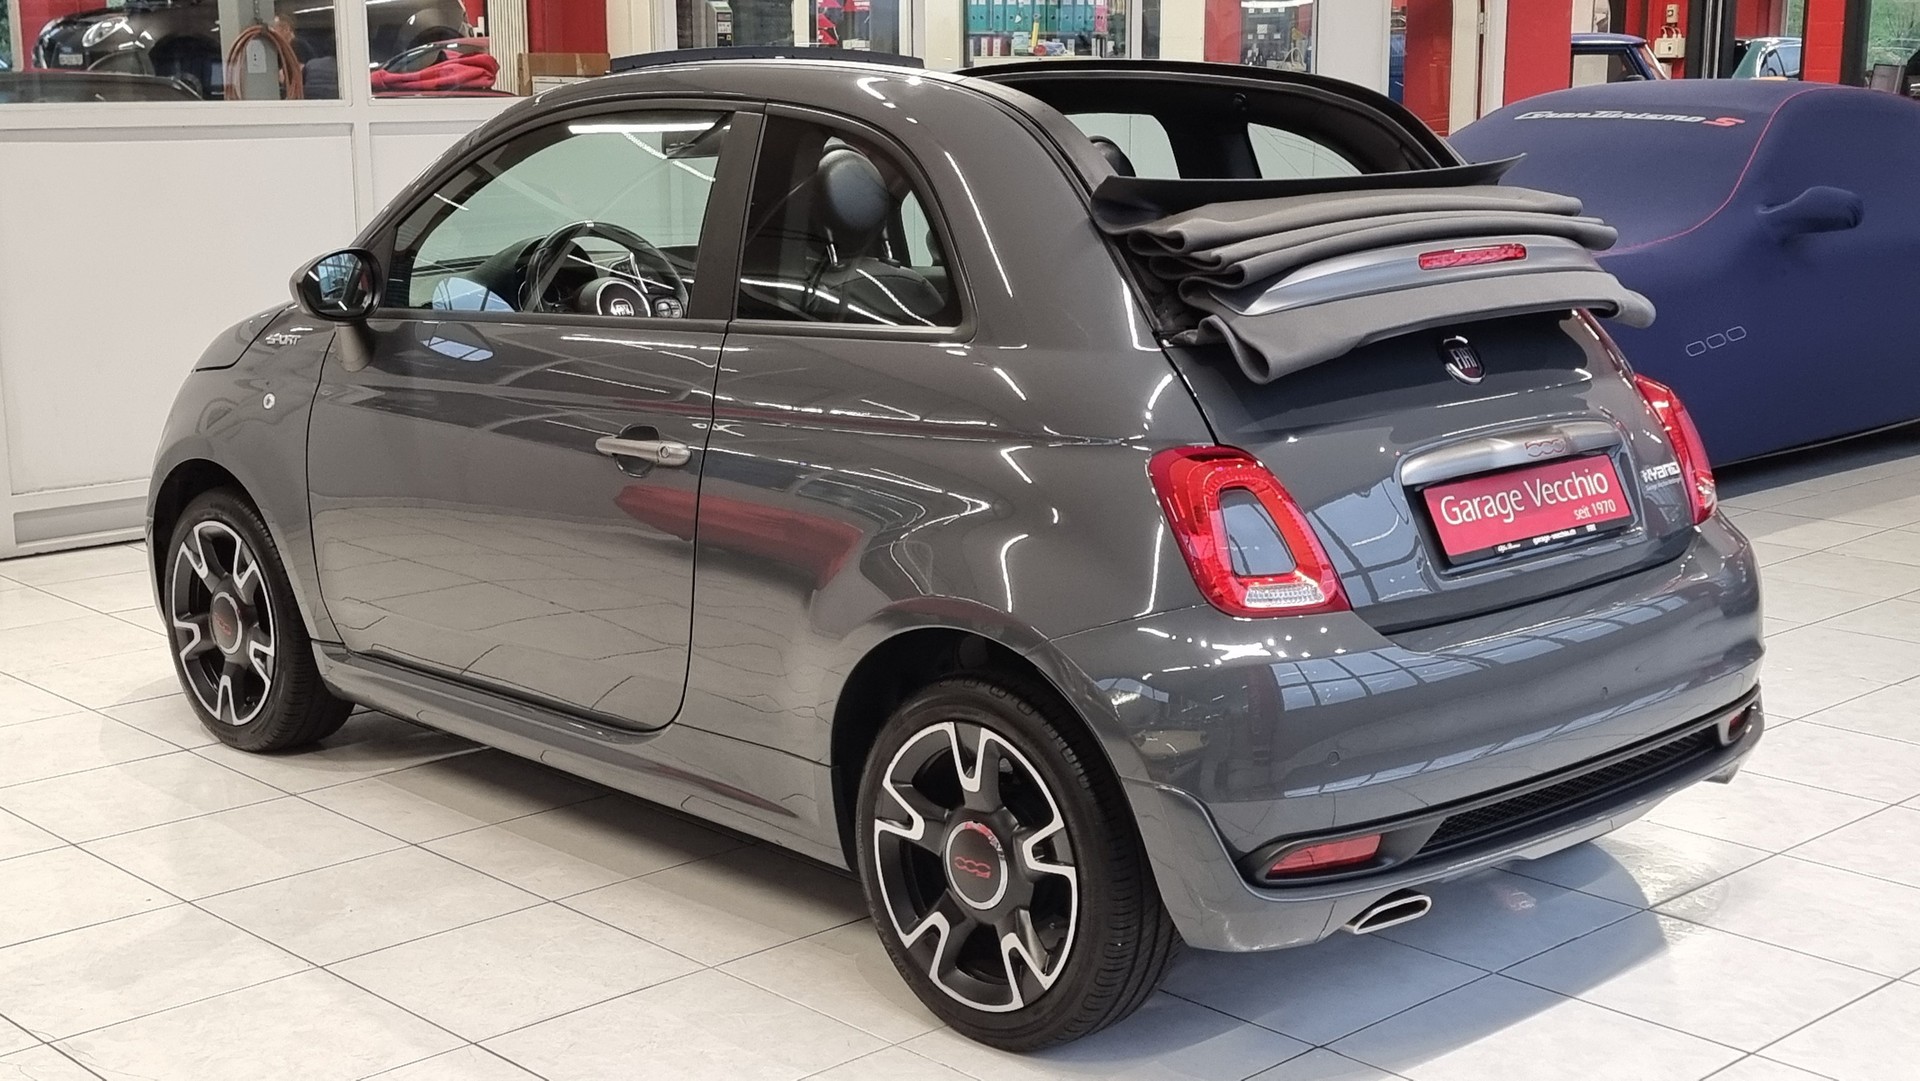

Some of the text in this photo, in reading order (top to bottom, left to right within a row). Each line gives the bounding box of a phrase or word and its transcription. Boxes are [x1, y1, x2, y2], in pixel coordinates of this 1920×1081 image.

[1703, 116, 1746, 128] S
[1449, 346, 1478, 370] FIAT
[1440, 468, 1609, 525] Garage Vecchio
[1573, 499, 1617, 521] seit 1970
